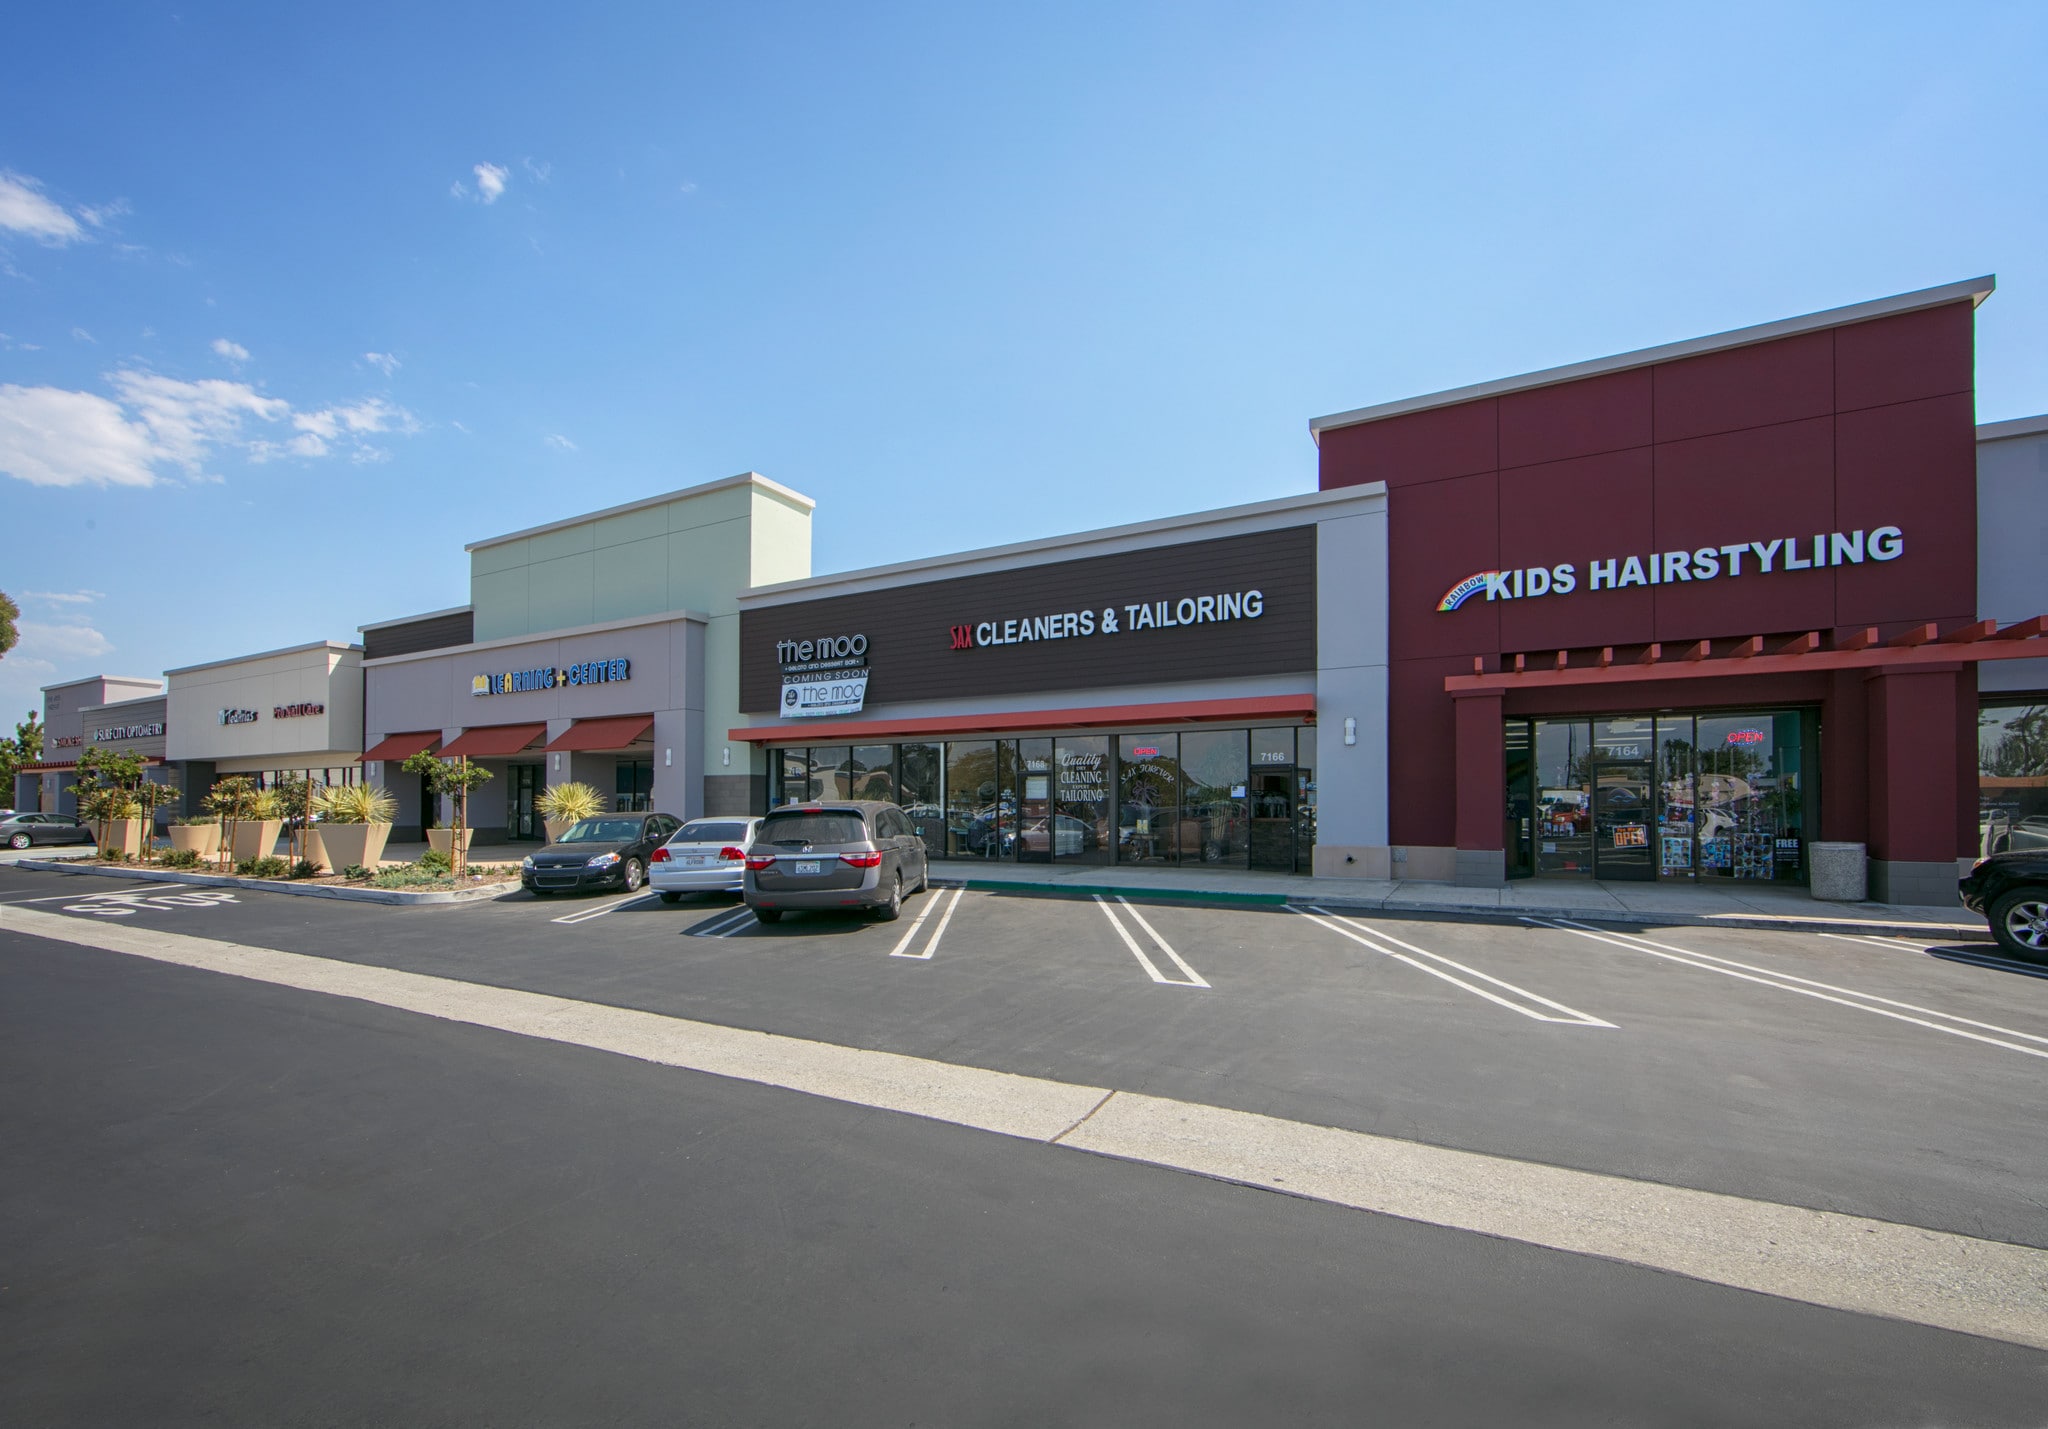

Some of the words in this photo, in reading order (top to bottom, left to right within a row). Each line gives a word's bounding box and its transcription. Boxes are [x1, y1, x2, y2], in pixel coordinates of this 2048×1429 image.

[1486, 564, 1575, 601] KIDS
[1590, 526, 1903, 591] HAIRSTYLING
[1444, 574, 1484, 606] RAINBOW
[950, 624, 973, 650] SAX
[976, 610, 1095, 647] CLEANERS
[1101, 607, 1119, 634] &
[1124, 590, 1264, 630] TAILORING
[777, 639, 814, 664] the
[817, 634, 867, 660] moo
[491, 667, 553, 694] LEARNING
[568, 658, 627, 686] CENTER
[783, 672, 831, 684] COMING
[835, 669, 869, 680] SOON
[802, 686, 827, 702] the
[98, 729, 112, 741] SURF
[113, 726, 126, 739] CITY
[126, 723, 163, 737] OPTOMETRY
[1727, 731, 1763, 744] OPEN
[1133, 747, 1158, 756] OPEN
[1261, 752, 1285, 762] 7166
[1608, 746, 1639, 757] 7164
[1061, 752, 1102, 771] Quality
[1061, 771, 1102, 784] CLEANING
[1060, 789, 1104, 802] TAILORING
[1615, 832, 1645, 846] OPEN
[1775, 839, 1799, 848] FREE
[62, 892, 242, 916] STOP
